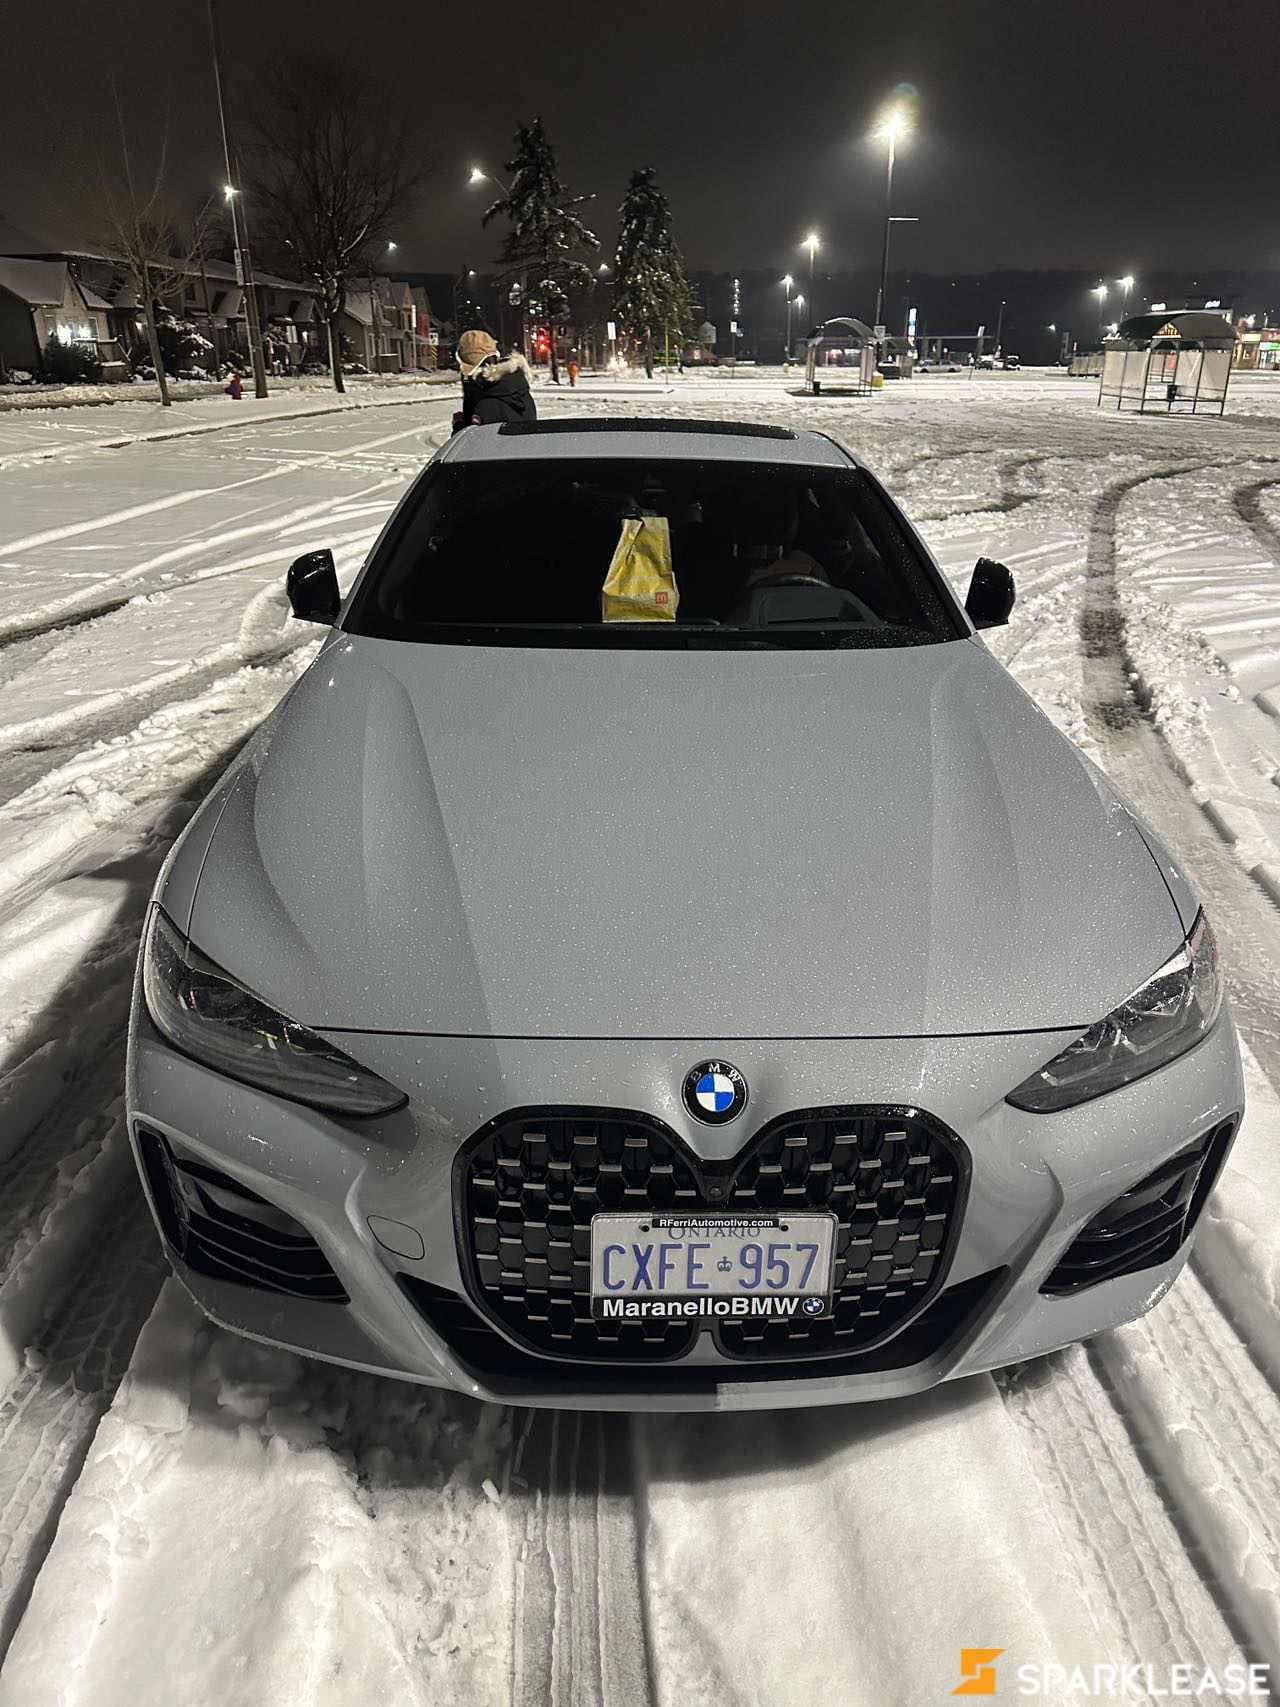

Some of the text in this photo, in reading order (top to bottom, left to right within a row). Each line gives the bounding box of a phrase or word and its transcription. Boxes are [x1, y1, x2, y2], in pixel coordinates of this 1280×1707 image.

[690, 1063, 741, 1082] BMW
[659, 1218, 773, 1228] RFerriAutomotive.com
[602, 1243, 819, 1290] CXFE 957
[602, 1297, 800, 1317] MaranelloBMW
